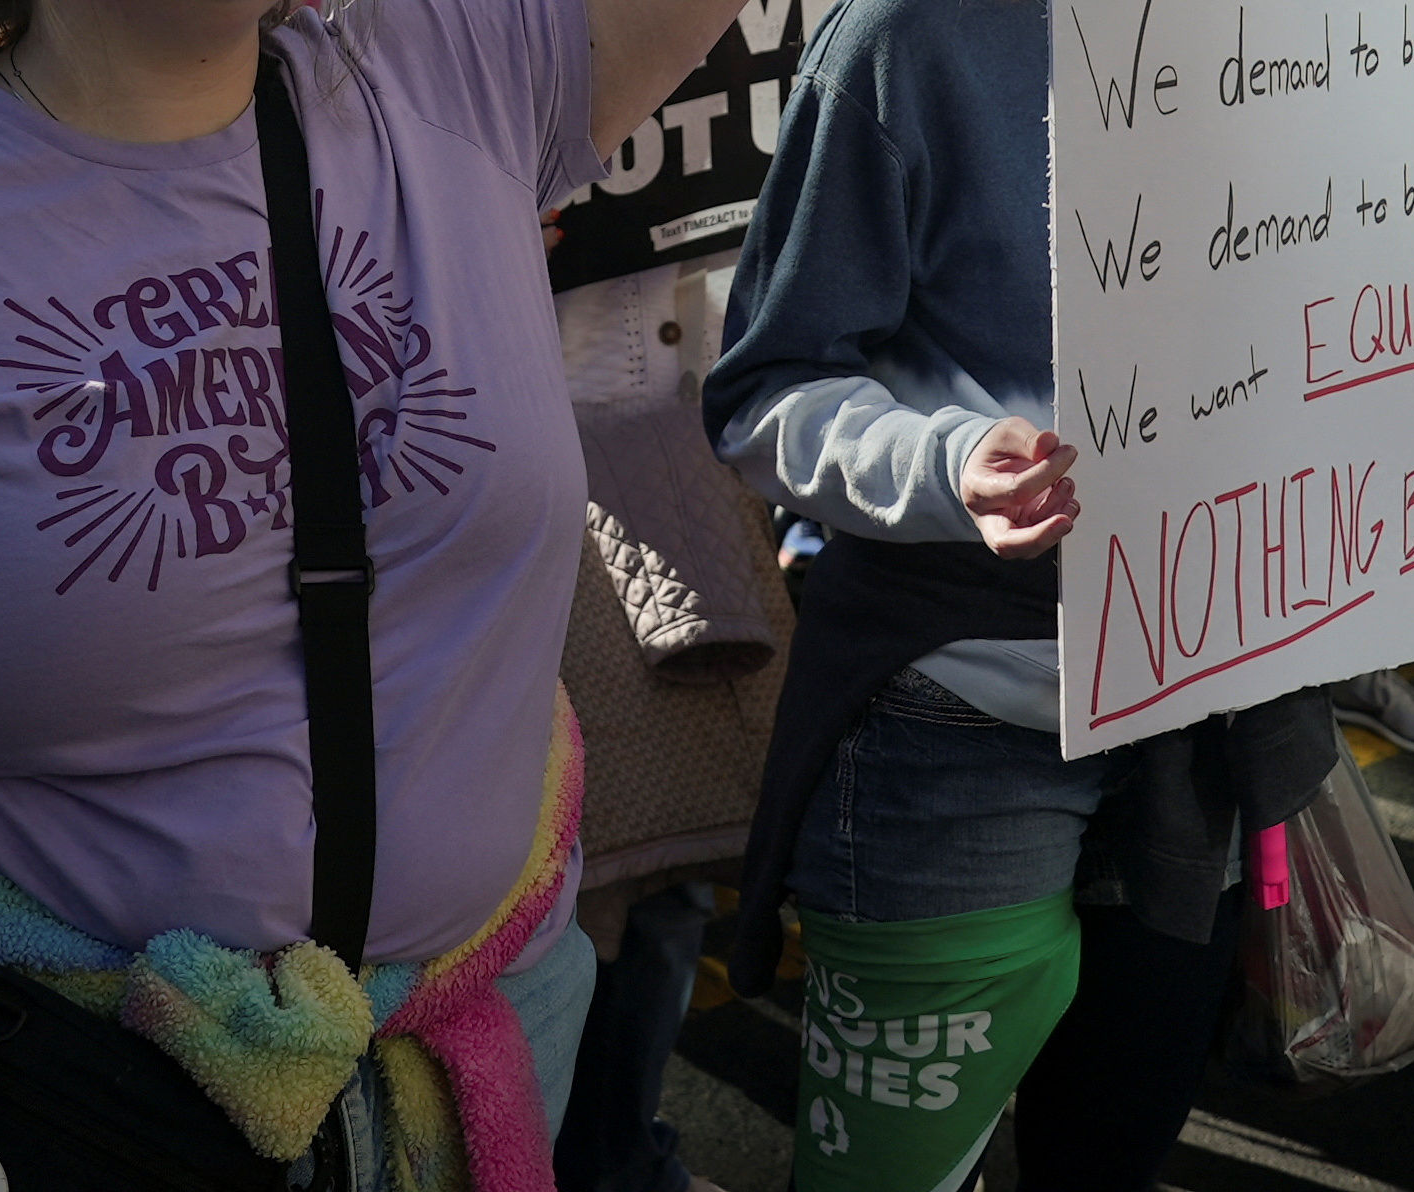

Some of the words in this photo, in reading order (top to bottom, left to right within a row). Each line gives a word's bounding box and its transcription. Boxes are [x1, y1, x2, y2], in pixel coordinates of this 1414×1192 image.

[1218, 5, 1333, 109] demand
[1350, 29, 1381, 78] to
[557, 90, 730, 210] OT
[1074, 194, 1163, 294] We
[1207, 175, 1333, 273] demand
[1356, 178, 1389, 224] to
[93, 245, 291, 350] GRE
[1077, 363, 1160, 457] We
[1190, 344, 1270, 424] want
[1090, 459, 1384, 718] NOTHING
[801, 1008, 963, 1112] DIES
